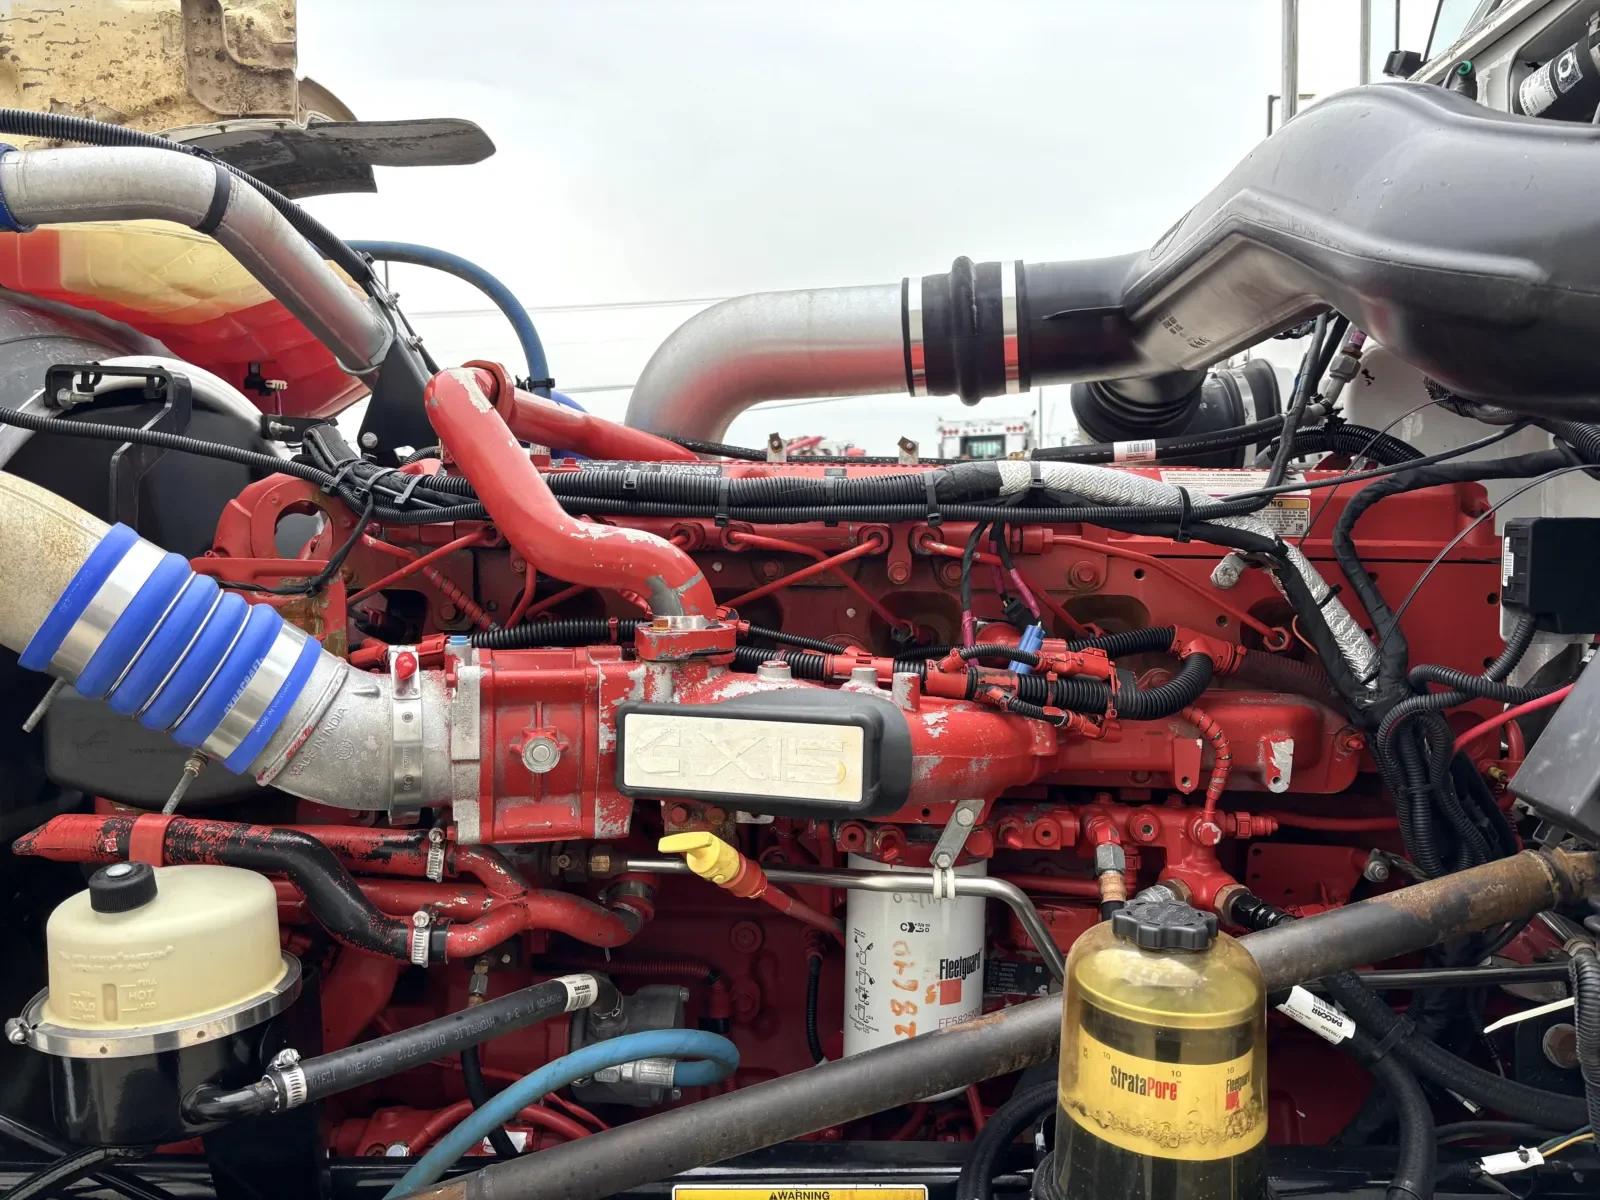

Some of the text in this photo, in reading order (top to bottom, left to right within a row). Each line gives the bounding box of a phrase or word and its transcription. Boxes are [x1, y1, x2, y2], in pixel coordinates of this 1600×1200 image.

[315, 735, 326, 751] IN
[324, 707, 347, 737] INDIA
[939, 948, 982, 981] Fleetguard
[128, 989, 155, 1000] HOT
[1311, 1006, 1344, 1028] PACCAR
[1227, 1066, 1234, 1074] 10
[1110, 1064, 1178, 1101] StrataPore
[778, 1191, 830, 1200] WARNING
